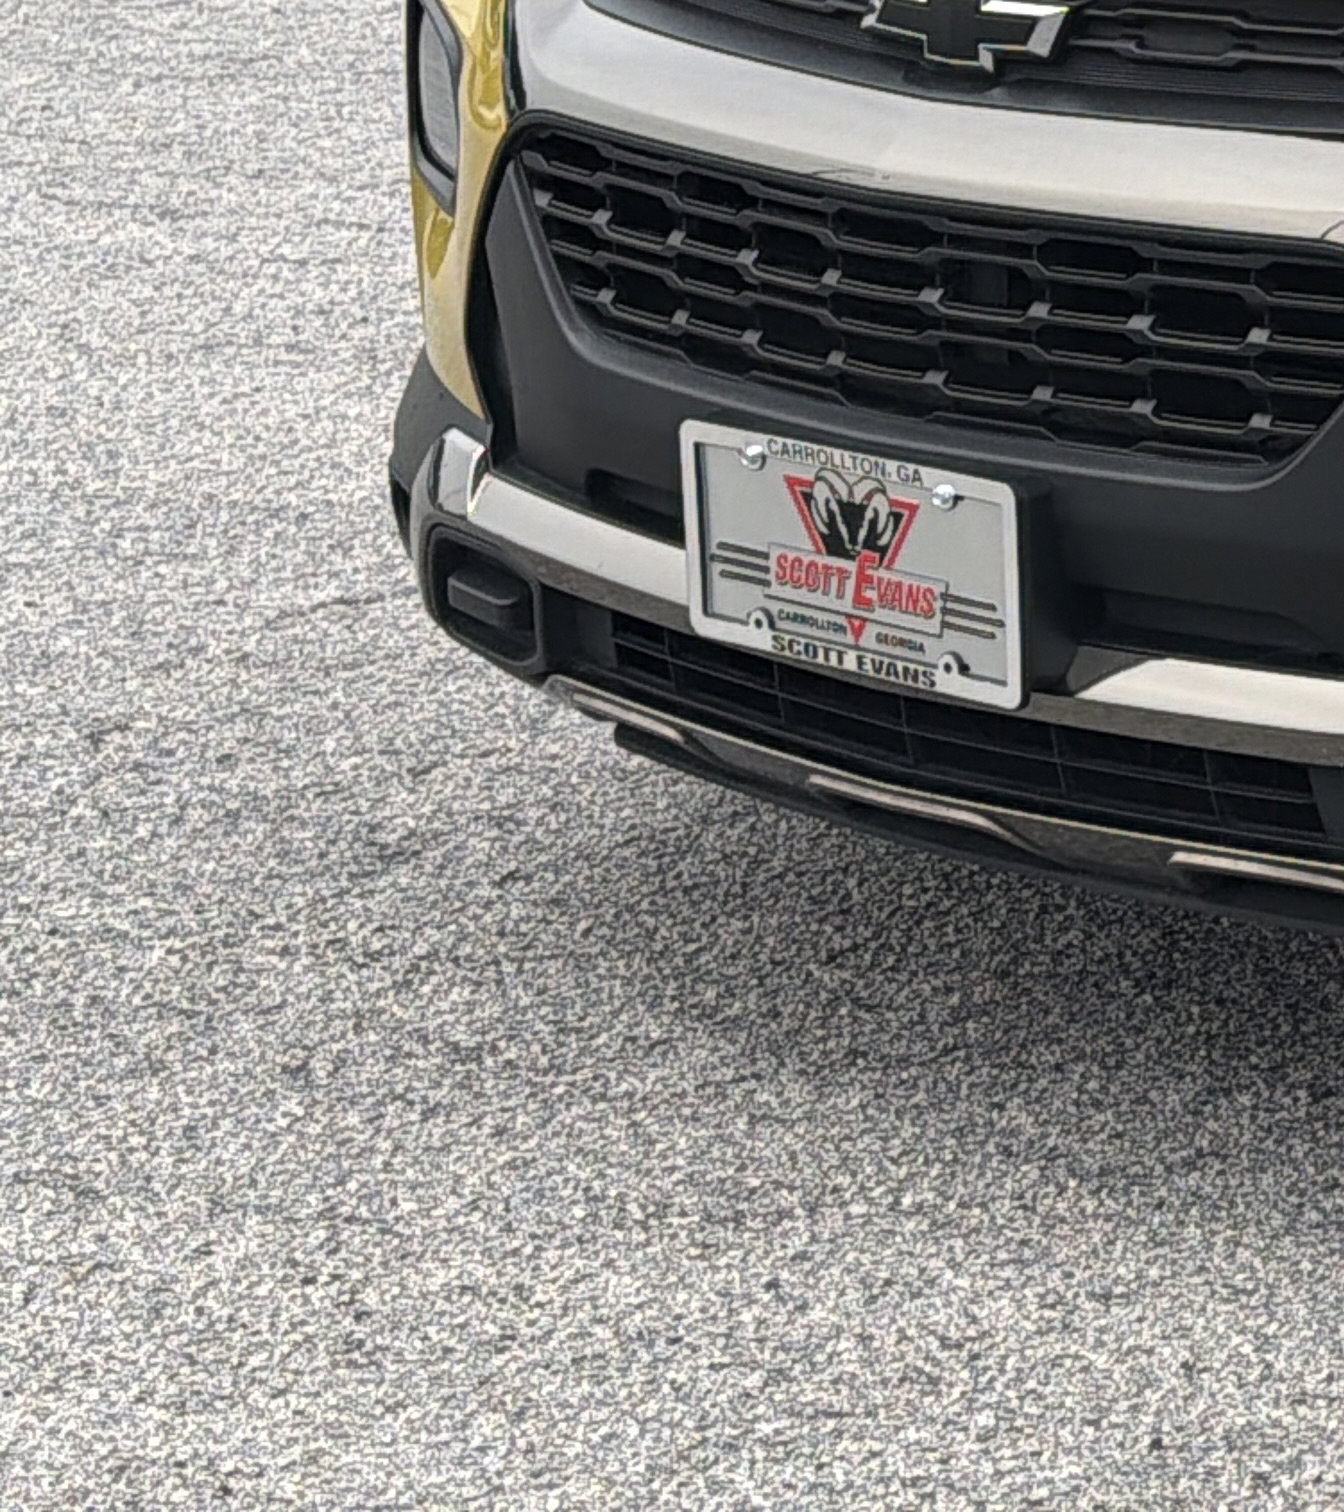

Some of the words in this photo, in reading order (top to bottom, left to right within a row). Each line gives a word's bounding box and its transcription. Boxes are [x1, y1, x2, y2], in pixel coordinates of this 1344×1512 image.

[896, 461, 924, 486] GA
[775, 553, 850, 598] SCOTT
[777, 608, 847, 636] CARROLLTON
[875, 632, 926, 655] GEORGIA
[771, 636, 848, 667] SCOTT
[856, 657, 937, 689] EVANS
